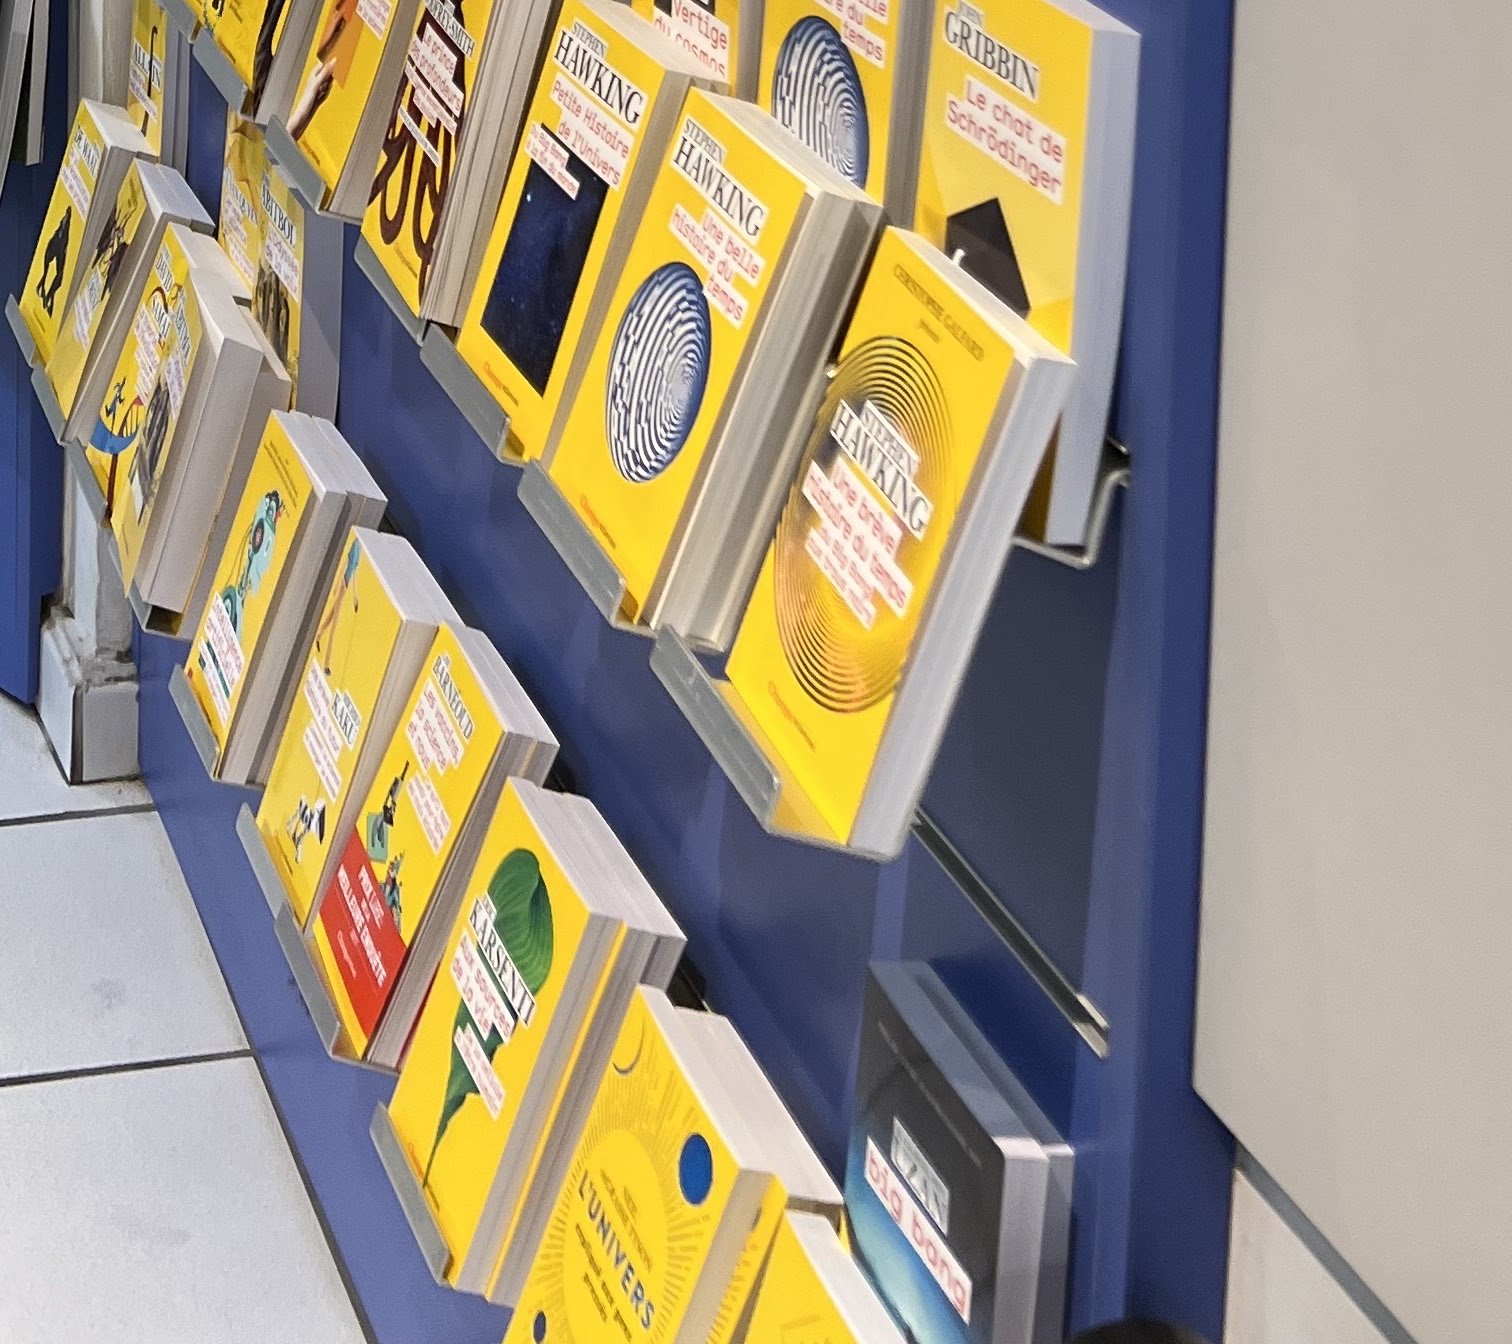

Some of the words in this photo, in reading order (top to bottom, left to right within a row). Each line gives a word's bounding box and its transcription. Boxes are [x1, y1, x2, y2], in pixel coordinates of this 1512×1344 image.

[571, 21, 608, 59] STEPHEN
[843, 19, 885, 63] temps
[848, 2, 865, 28] du
[945, 10, 1039, 101] GRIBBIN
[554, 30, 643, 125] HAWKING
[553, 79, 582, 119] Petite
[583, 107, 630, 160] Histoire
[558, 120, 572, 142] de
[571, 127, 622, 187] l'Univers
[684, 117, 726, 165] STEPHEN
[947, 99, 1064, 196] Schrödinger
[967, 80, 987, 110] Le
[993, 99, 1034, 146] chat
[1040, 134, 1063, 164] de
[673, 135, 764, 238] HAWKING
[702, 214, 725, 243] Une
[724, 233, 761, 281] belle
[717, 253, 735, 283] du
[706, 274, 745, 322] temps
[834, 407, 930, 534] HAWKING
[469, 896, 537, 1028] KARSENTI
[578, 1168, 656, 1332] L'UNIVERS
[868, 1152, 904, 1227] big
[912, 1220, 968, 1318] bang
